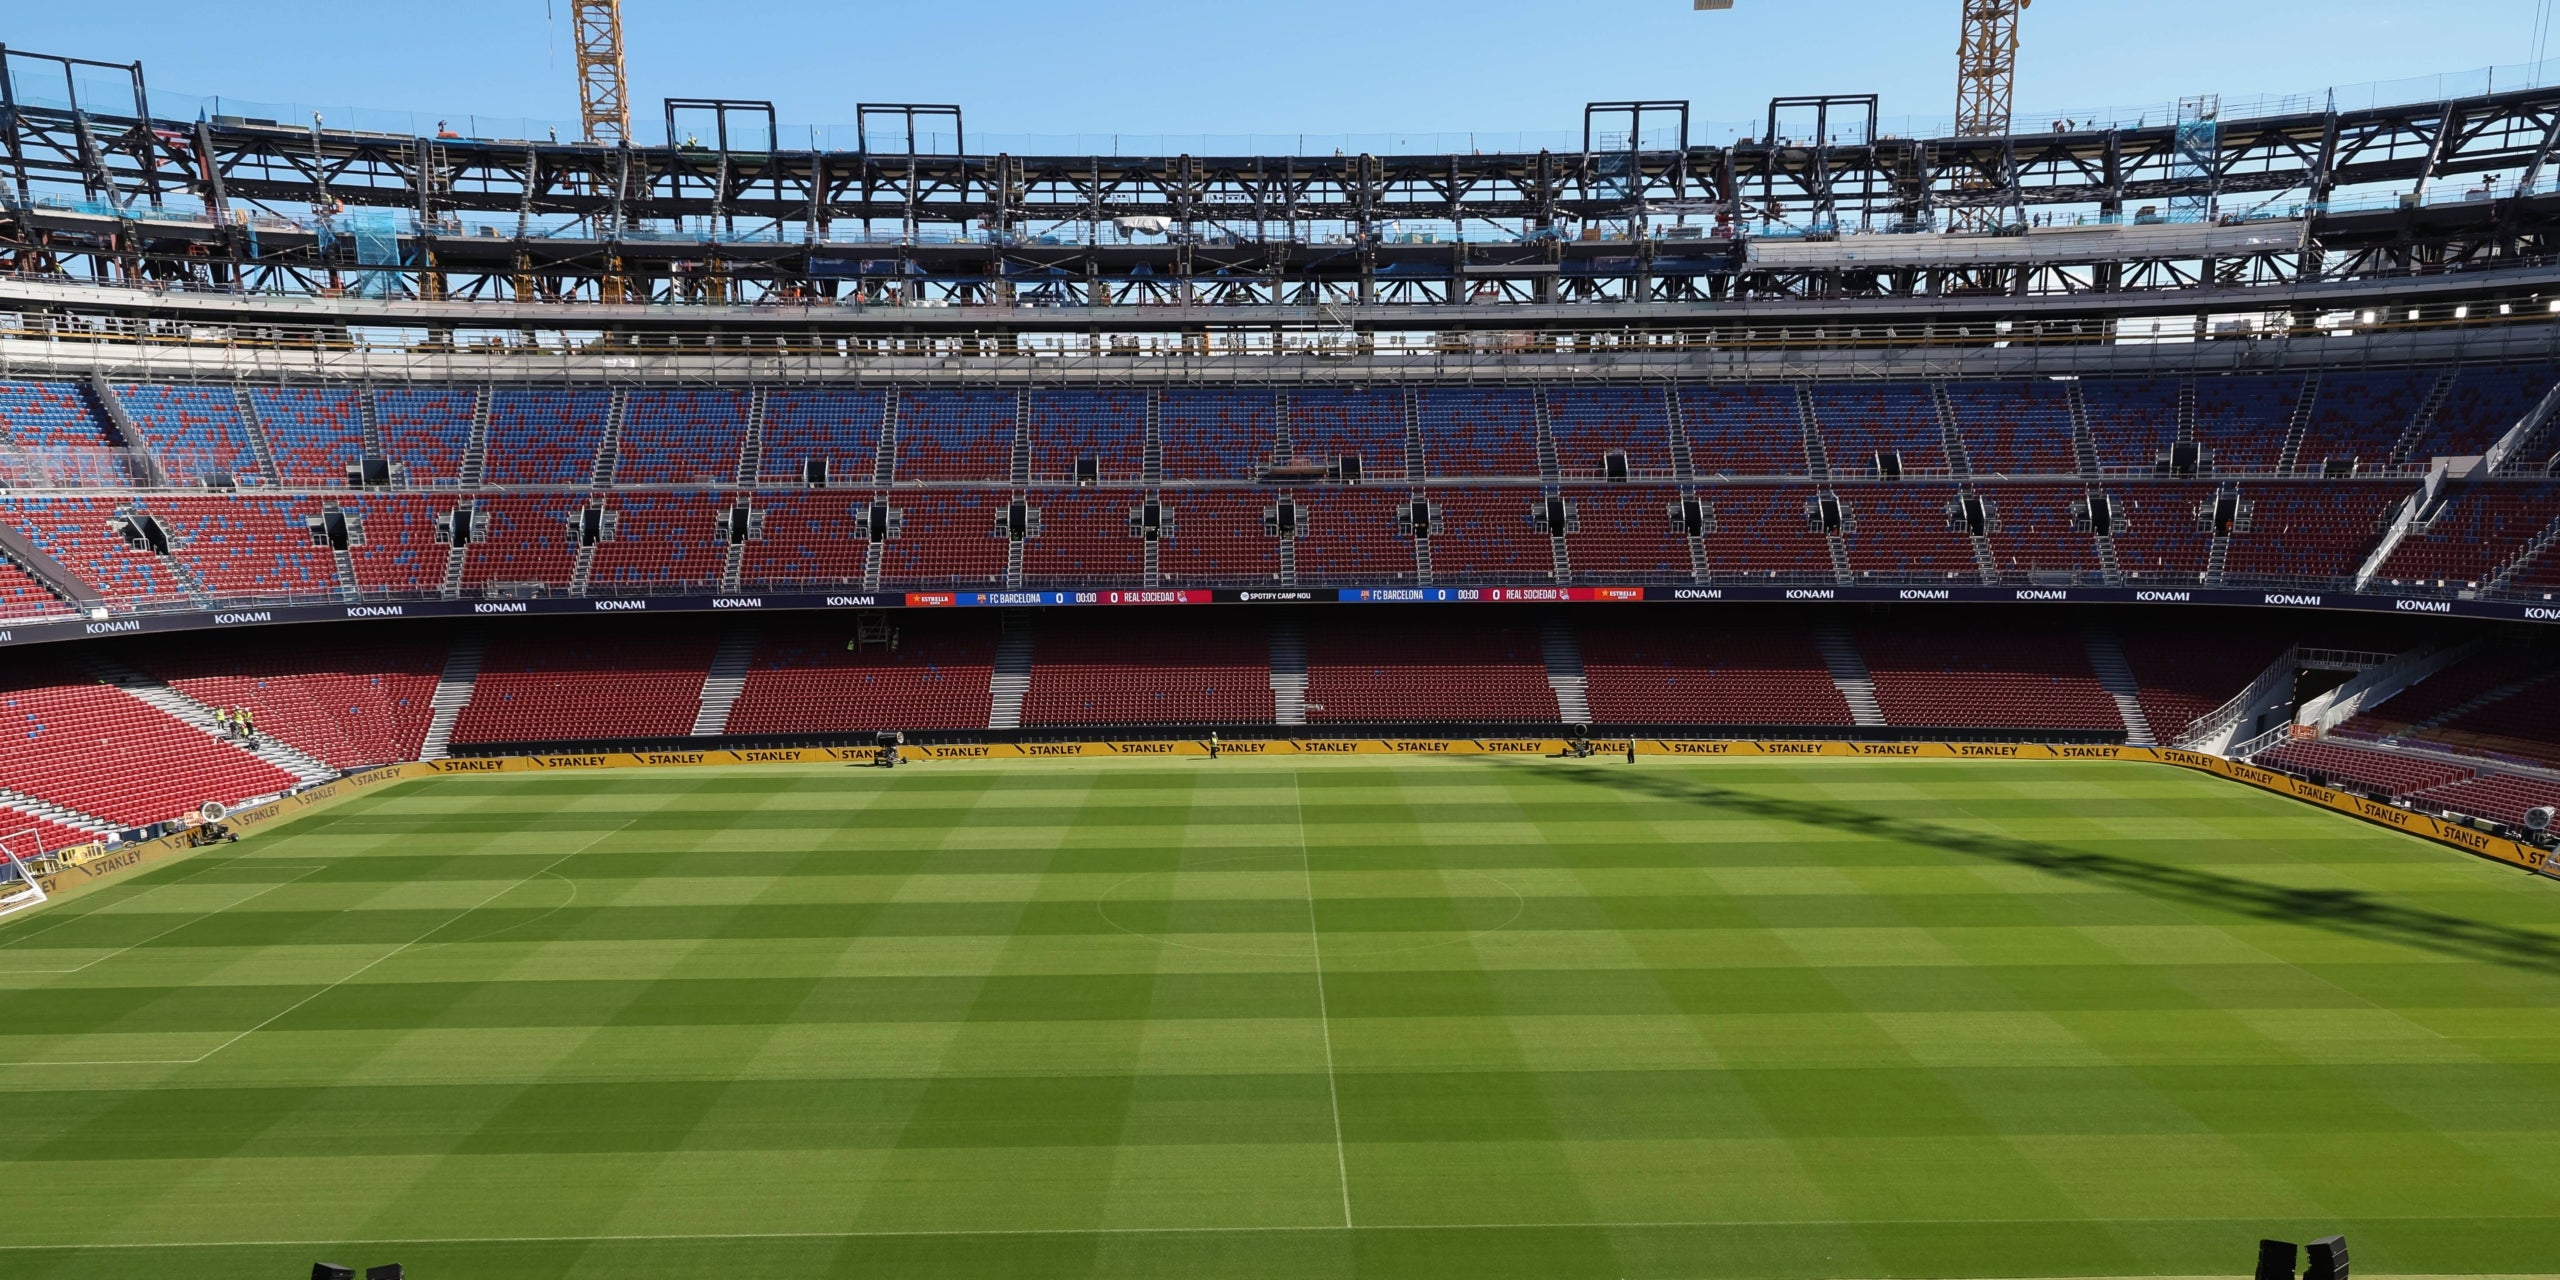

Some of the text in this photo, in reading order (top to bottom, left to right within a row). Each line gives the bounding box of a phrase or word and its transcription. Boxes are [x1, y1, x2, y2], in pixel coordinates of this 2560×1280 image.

[990, 592, 1174, 603] FC BARCELONA 0 00:00 0 REAL SOCIEDAD
[1374, 590, 1556, 600] FC BARCELONA 0 00:00 0 REAL SOCIEDAD
[1675, 590, 1721, 598] KONAMI
[1786, 590, 1833, 598] KONAMI
[1900, 590, 1948, 598] KONAMI
[2017, 591, 2066, 599] KONAMI
[2137, 592, 2189, 600] KONAMI
[596, 601, 645, 609] KONAMI
[713, 599, 761, 607] KONAMI
[827, 597, 874, 605] KONAMI
[2265, 595, 2320, 605] KONAMI
[475, 603, 526, 612] KONAMI
[2396, 600, 2450, 611] KONAMI
[347, 606, 402, 616] KONAMI
[214, 611, 270, 623] KONAMI
[86, 620, 139, 633] KONAMI
[936, 747, 989, 757] STANLEY
[1030, 745, 1082, 755] STANLEY
[1122, 743, 1174, 753] STANLEY
[1305, 742, 1358, 752] STANLEY
[1397, 742, 1449, 752] STANLEY
[1489, 742, 1541, 752] STANLEY
[1589, 743, 1628, 752] TANLE
[1674, 743, 1728, 753] STANLEY
[1769, 744, 1822, 753] STANLEY
[1864, 745, 1919, 755] STANLEY
[1961, 745, 2017, 756] STANLEY
[2063, 747, 2119, 757] STANLEY
[649, 754, 703, 764] STANLEY
[747, 751, 800, 762] STANLEY
[842, 749, 880, 759] STAN
[549, 756, 605, 767] STANLEY
[2164, 751, 2214, 768] STANLEY
[445, 760, 503, 771] STANLEY
[357, 768, 400, 786] STANLEY
[2234, 766, 2273, 785] STANLEY
[305, 785, 336, 804] STANLEY
[2298, 784, 2335, 804] STANLEY
[243, 804, 280, 825] STANLEY
[2364, 803, 2408, 826] STANLEY
[2443, 827, 2489, 849] STANLEY
[95, 852, 141, 875] STANLEY
